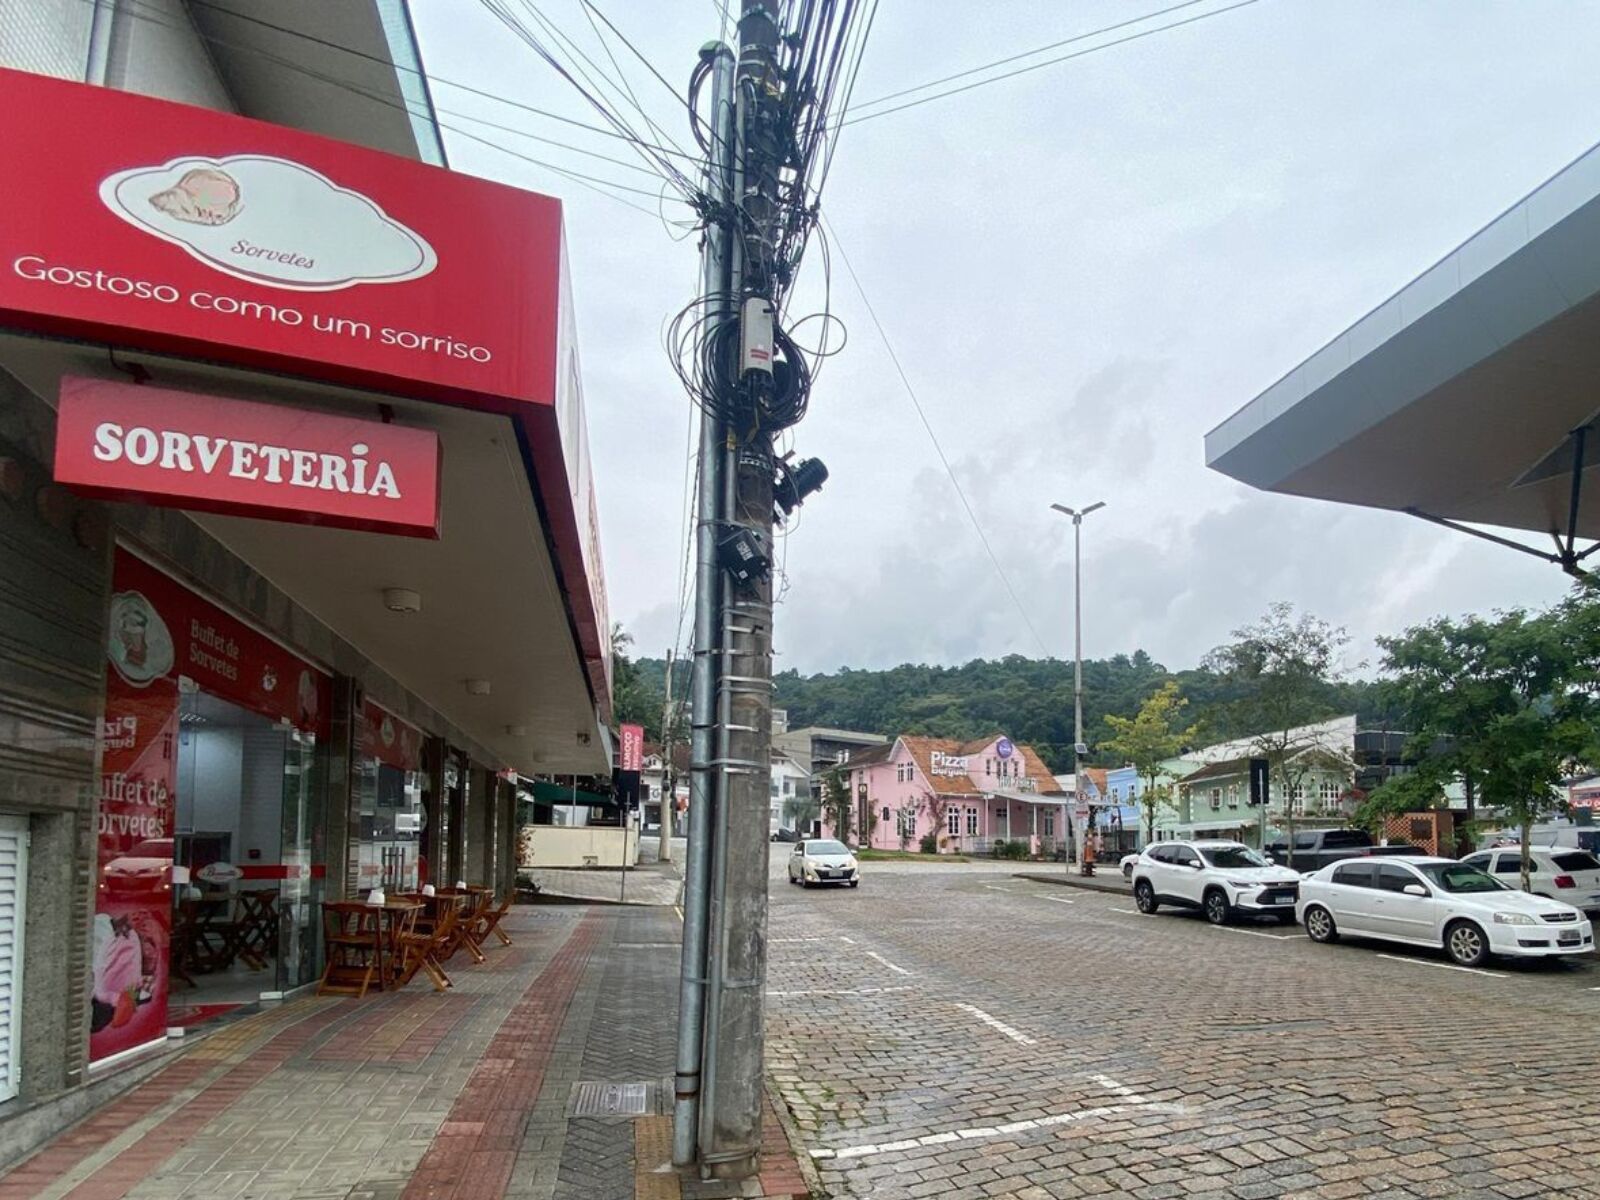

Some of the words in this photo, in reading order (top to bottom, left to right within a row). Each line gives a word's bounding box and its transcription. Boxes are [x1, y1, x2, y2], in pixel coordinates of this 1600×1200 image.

[230, 239, 315, 269] Sorvetes
[13, 255, 180, 303] Gostoso
[189, 291, 303, 326] como
[312, 313, 371, 339] um
[380, 327, 492, 363] sorriso
[191, 617, 225, 654] Buffet
[226, 638, 239, 660] de
[189, 642, 238, 681] Sorvetes
[931, 751, 968, 767] Pizza
[101, 772, 143, 805] uffet
[147, 779, 168, 808] de
[98, 812, 165, 838] orvetes
